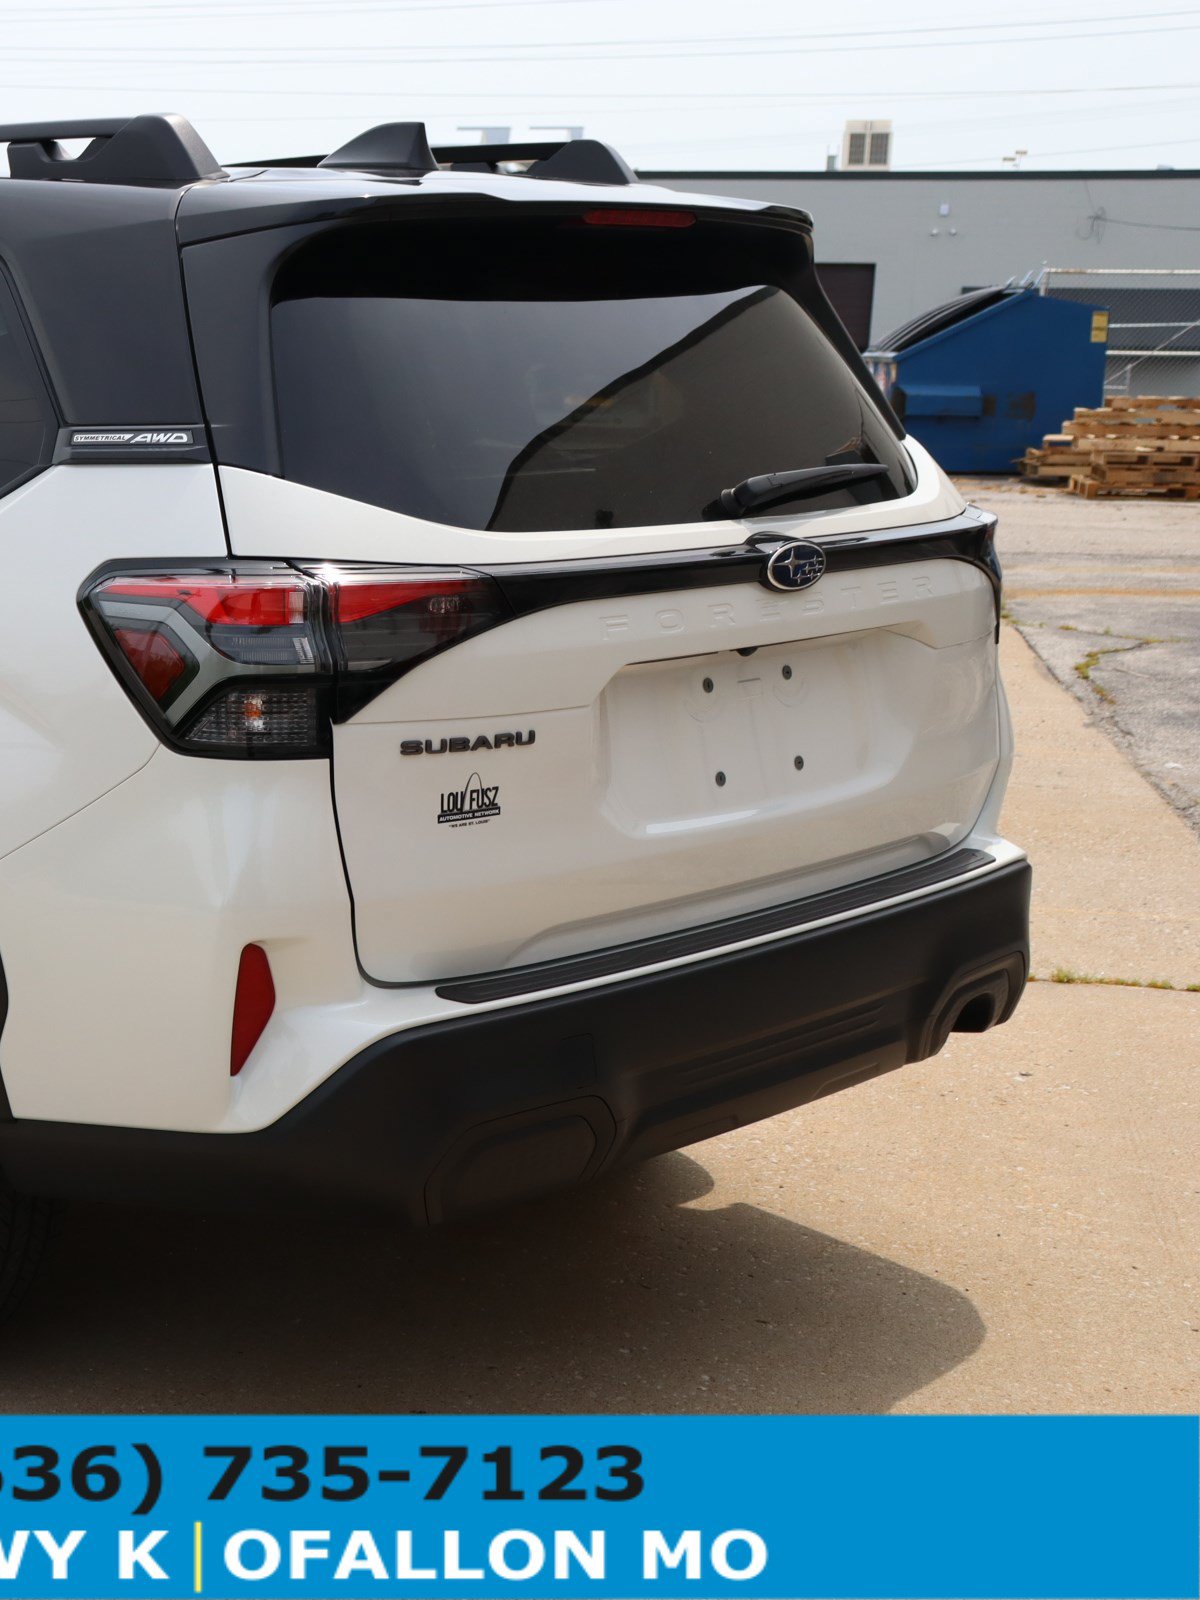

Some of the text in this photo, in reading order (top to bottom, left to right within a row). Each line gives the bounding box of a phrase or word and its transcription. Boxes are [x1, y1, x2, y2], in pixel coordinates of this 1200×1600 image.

[74, 432, 188, 443] SYMMETRICAL AWD
[599, 575, 936, 642] FORESTER
[400, 730, 536, 756] SUBARU
[440, 786, 499, 814] LOU FUSZ
[439, 809, 500, 822] AUTOMOTIVE NETWORK
